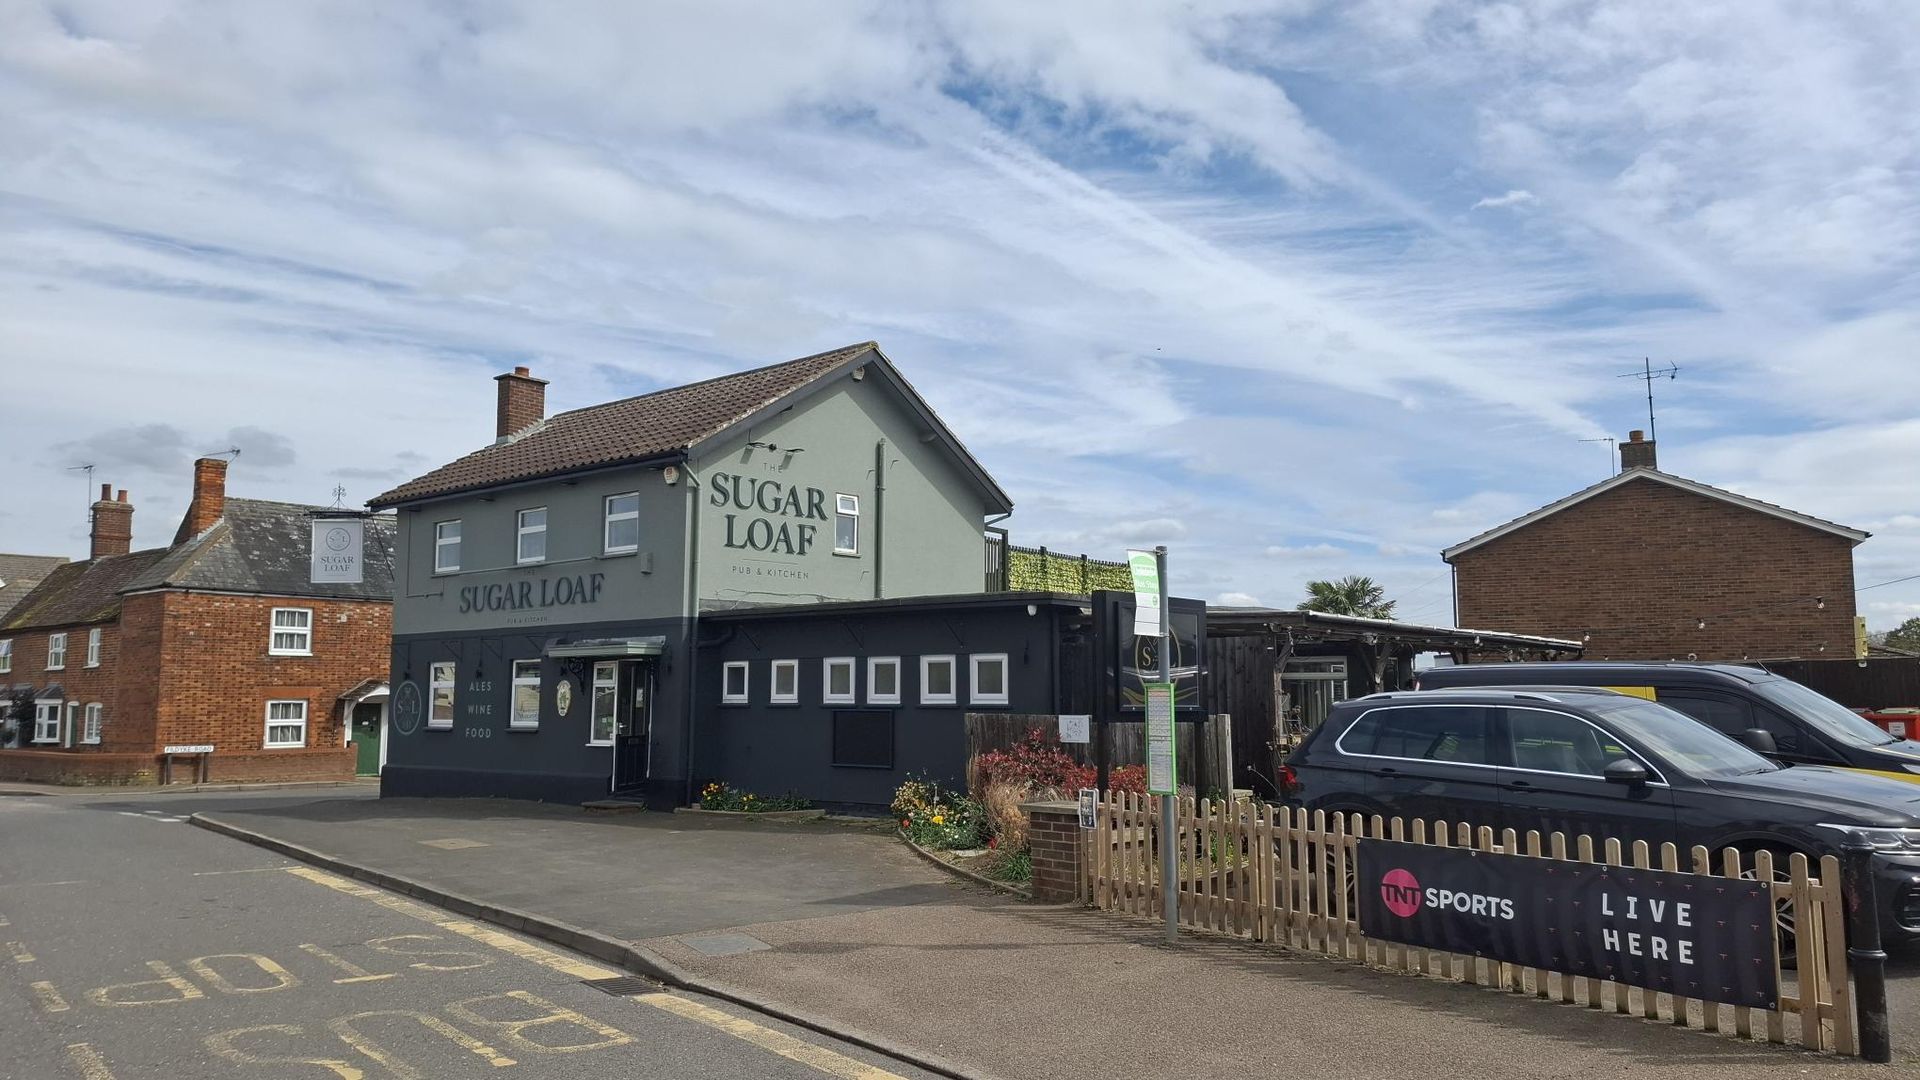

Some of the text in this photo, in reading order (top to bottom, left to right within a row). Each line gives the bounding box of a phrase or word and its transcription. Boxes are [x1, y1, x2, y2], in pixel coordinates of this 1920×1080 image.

[763, 462, 784, 474] THE
[710, 472, 829, 521] SUGAR
[724, 514, 817, 556] LOAF
[320, 555, 354, 564] SUGAR
[323, 564, 350, 572] LOAF
[732, 566, 809, 580] PUB & KITCHEN
[459, 573, 605, 614] SUGAR LOAF
[1142, 646, 1151, 666] S
[469, 681, 492, 692] ALES
[397, 700, 418, 714] S L
[467, 704, 492, 715] WINE
[465, 728, 491, 738] FOOD
[1382, 884, 1515, 921] TNT SPORTS
[1602, 893, 1692, 927] LIVE
[1603, 928, 1694, 965] HERE
[83, 934, 496, 1006] STOP
[204, 990, 639, 1080] BUS
